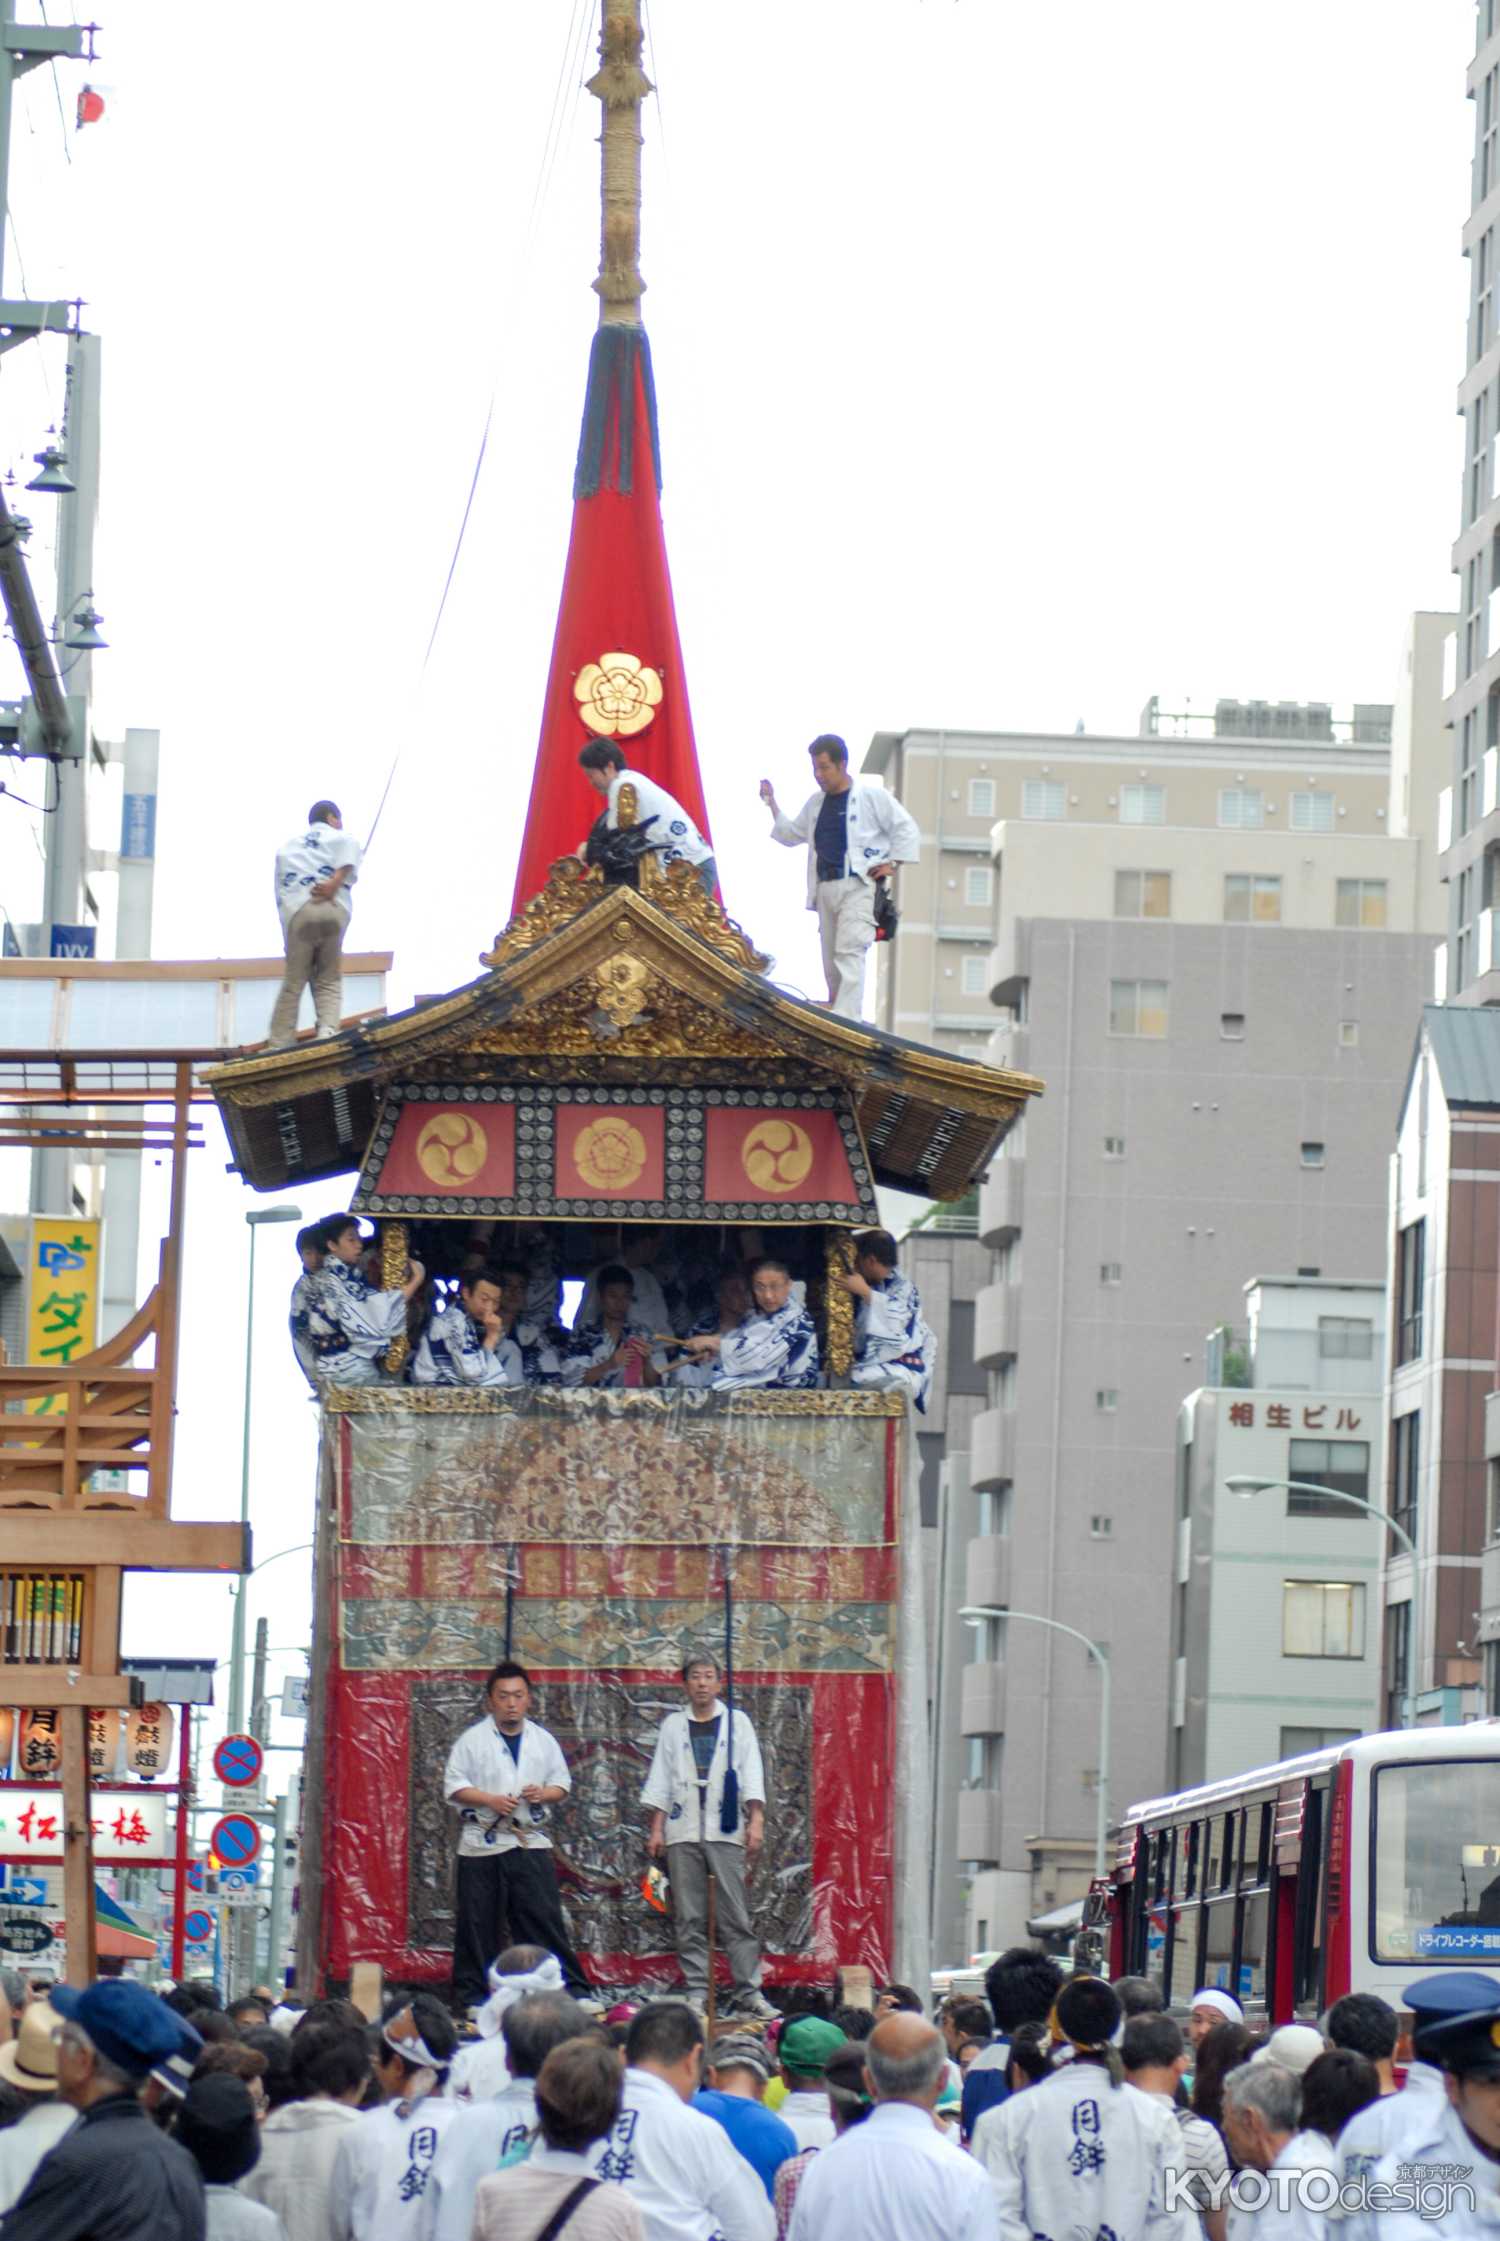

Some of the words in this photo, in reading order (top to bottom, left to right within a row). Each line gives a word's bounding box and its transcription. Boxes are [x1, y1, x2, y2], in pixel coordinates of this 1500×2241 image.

[1229, 1403, 1360, 1430] 相生ビル
[17, 1800, 152, 1846] 松梅
